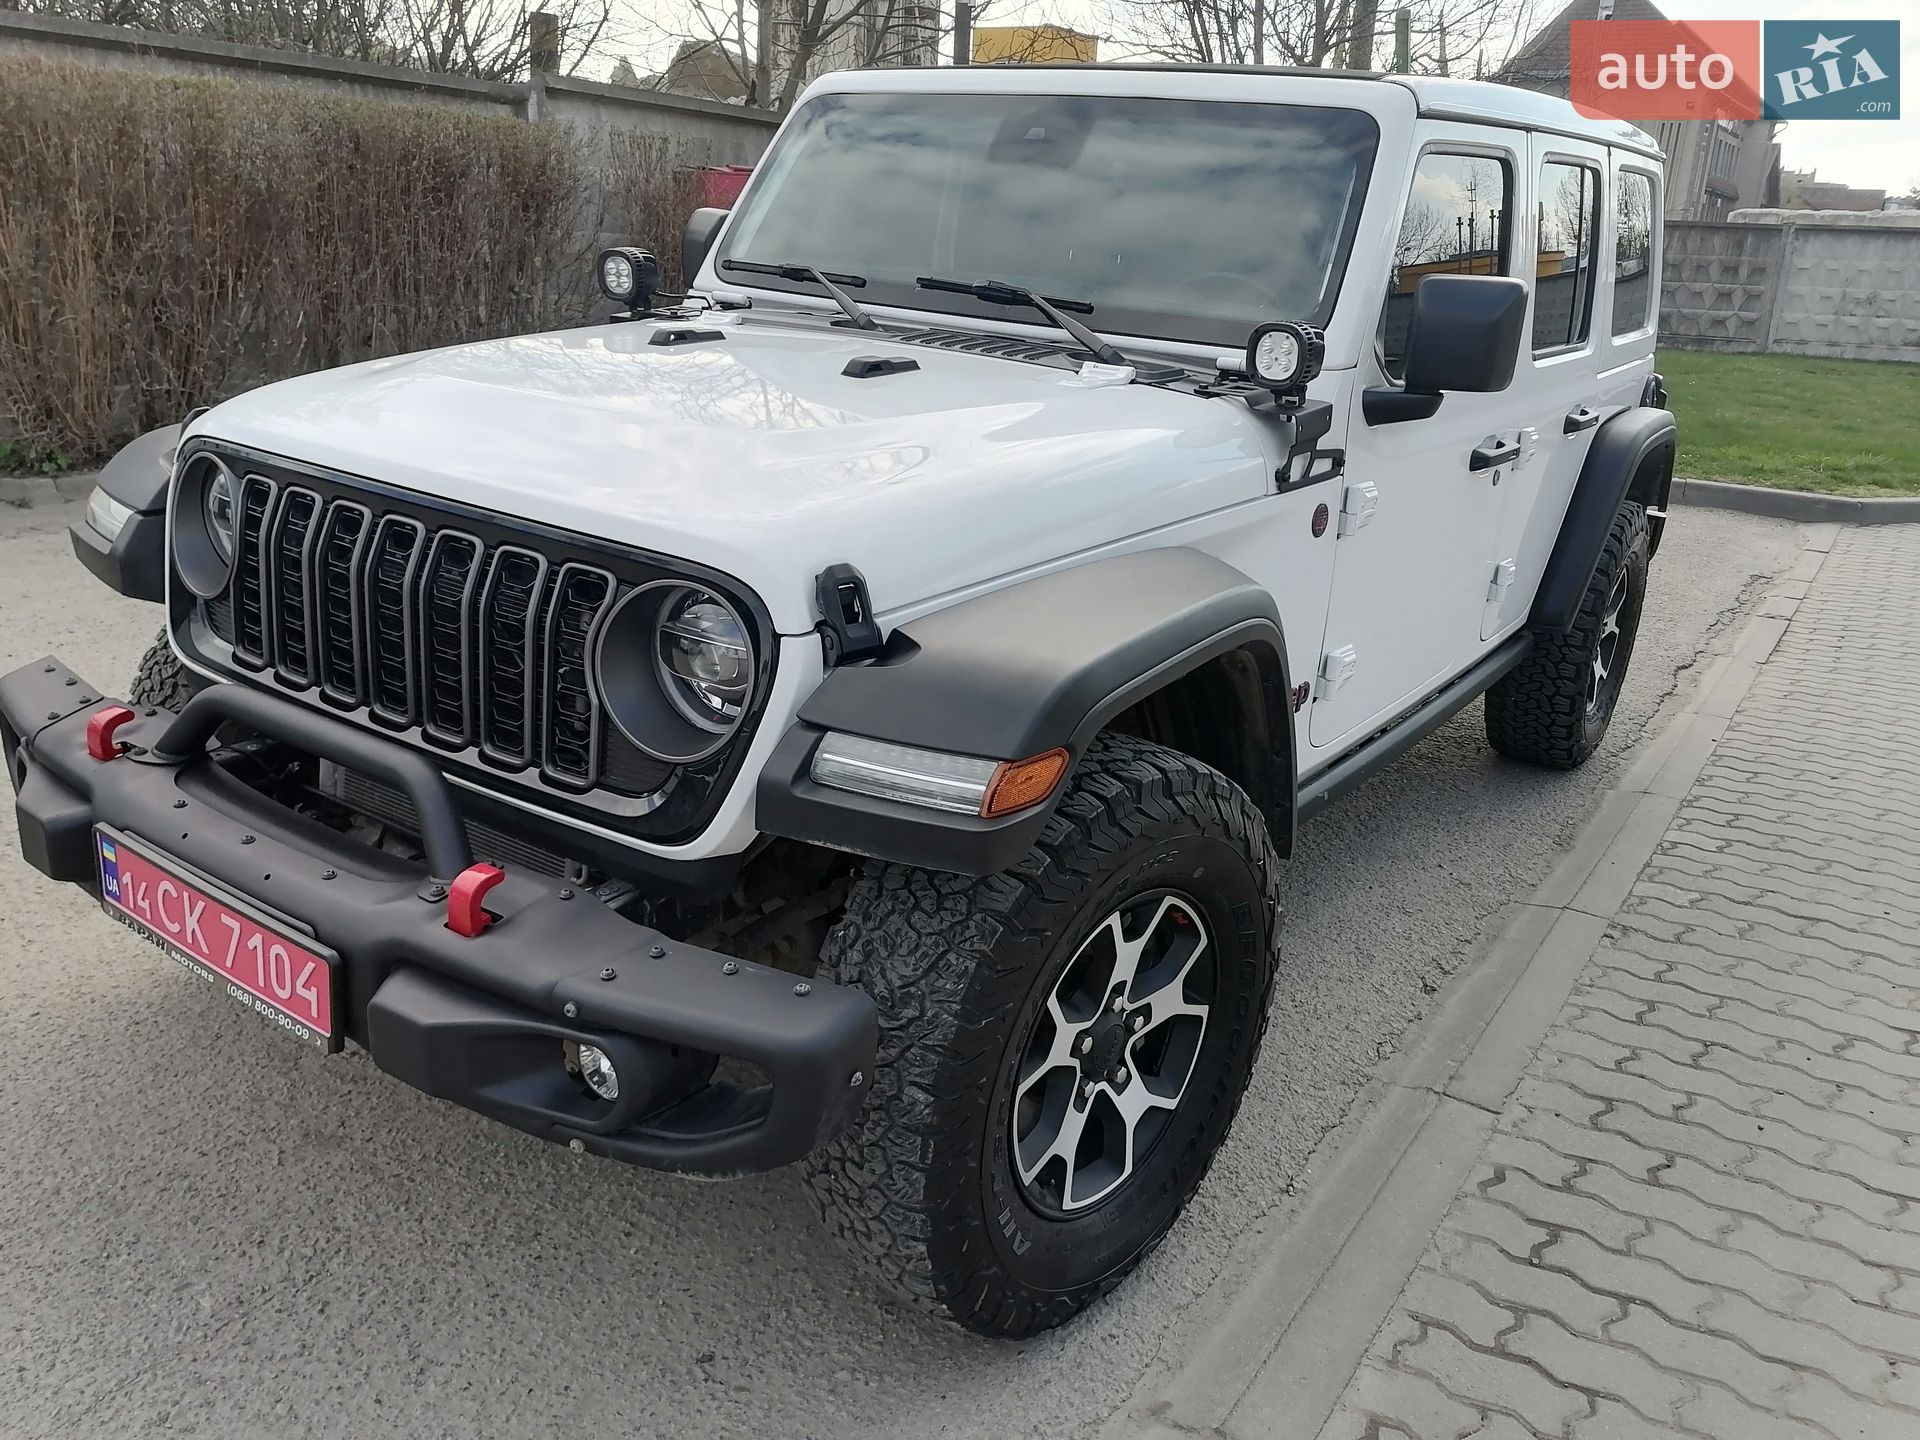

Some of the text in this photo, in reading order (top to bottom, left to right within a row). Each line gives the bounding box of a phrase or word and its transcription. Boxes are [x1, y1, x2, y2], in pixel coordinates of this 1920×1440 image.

[107, 874, 119, 896] UA
[171, 950, 215, 983] MOTORS
[226, 982, 253, 1007] (068)
[254, 1000, 310, 1040] 800-90-09
[219, 912, 319, 1017] 7104
